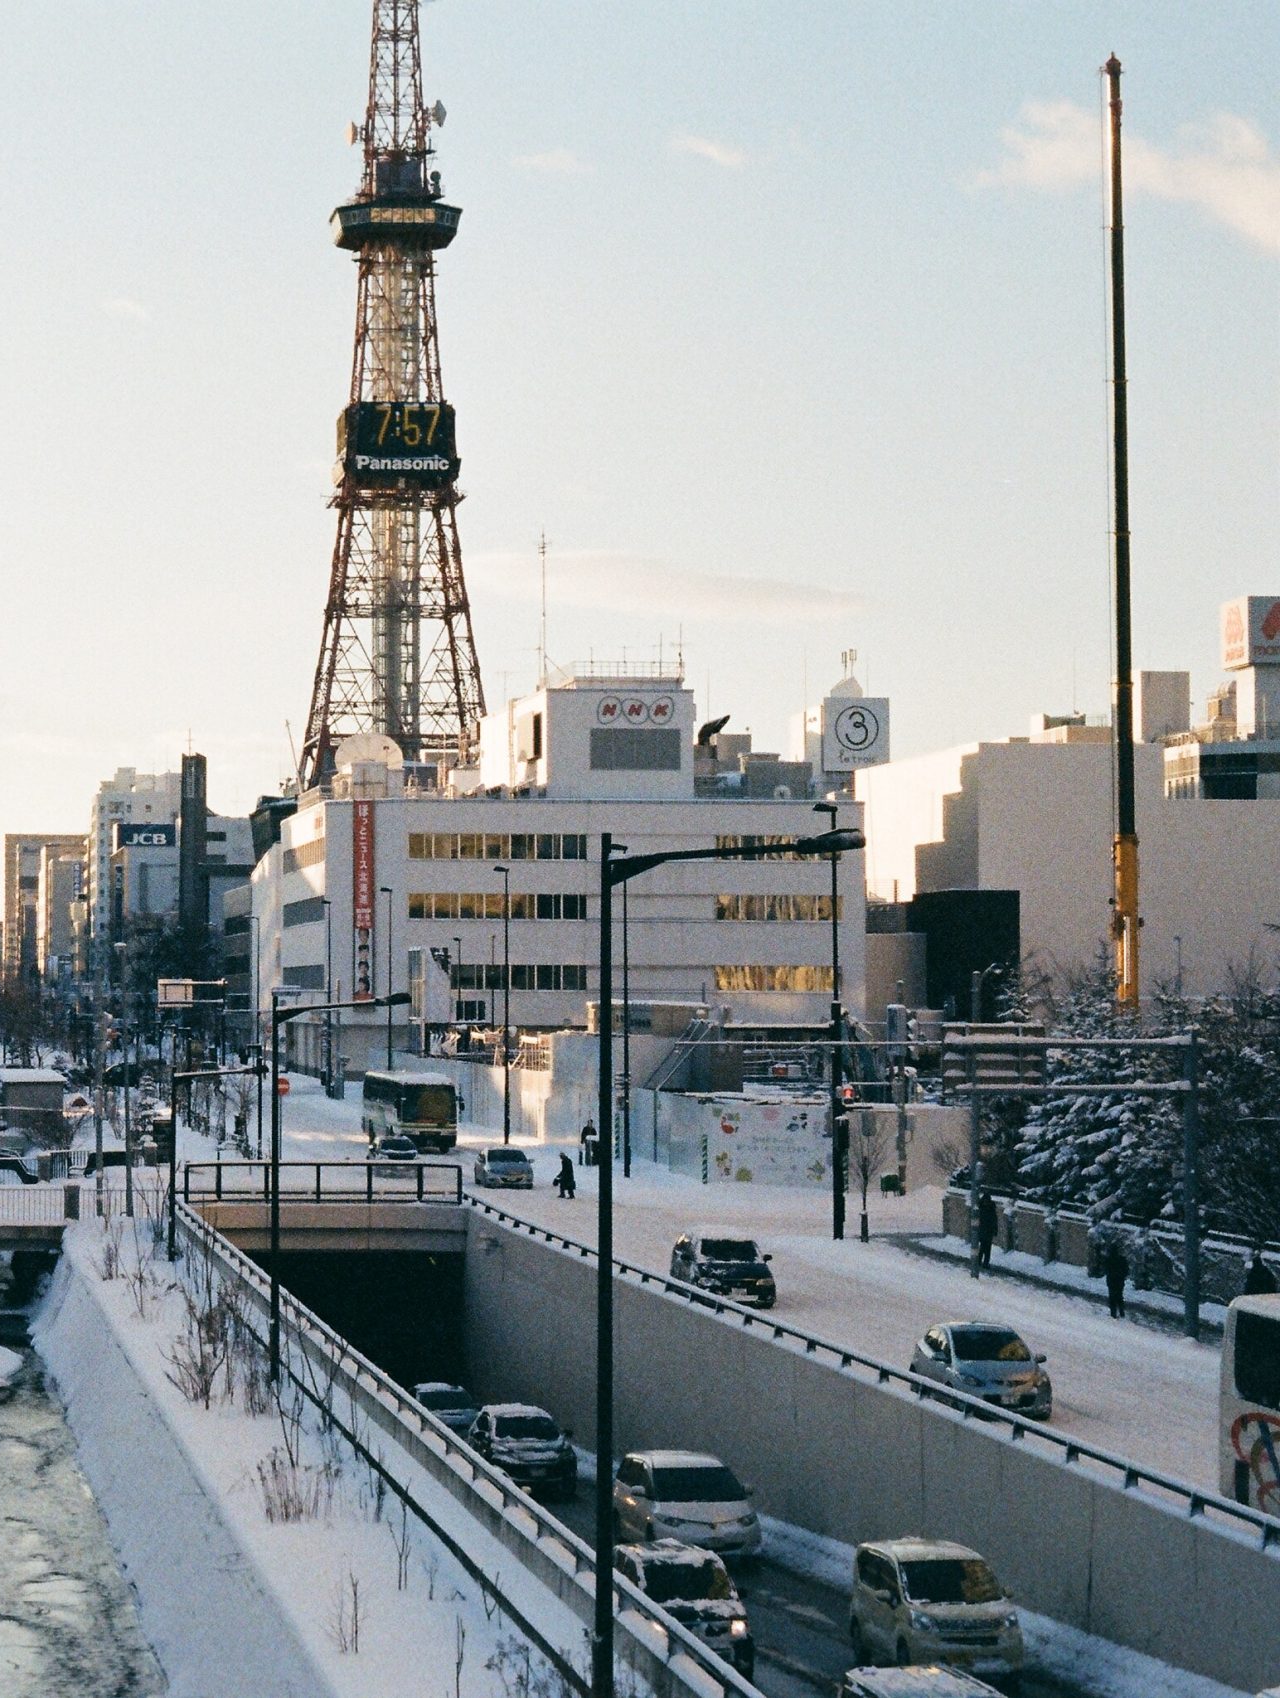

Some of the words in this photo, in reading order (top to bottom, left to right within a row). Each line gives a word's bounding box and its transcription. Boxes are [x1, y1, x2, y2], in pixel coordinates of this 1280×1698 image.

[375, 403, 440, 446] 7:57
[356, 455, 450, 471] Panasonic
[600, 701, 671, 719] NHK
[125, 833, 167, 845] JCB
